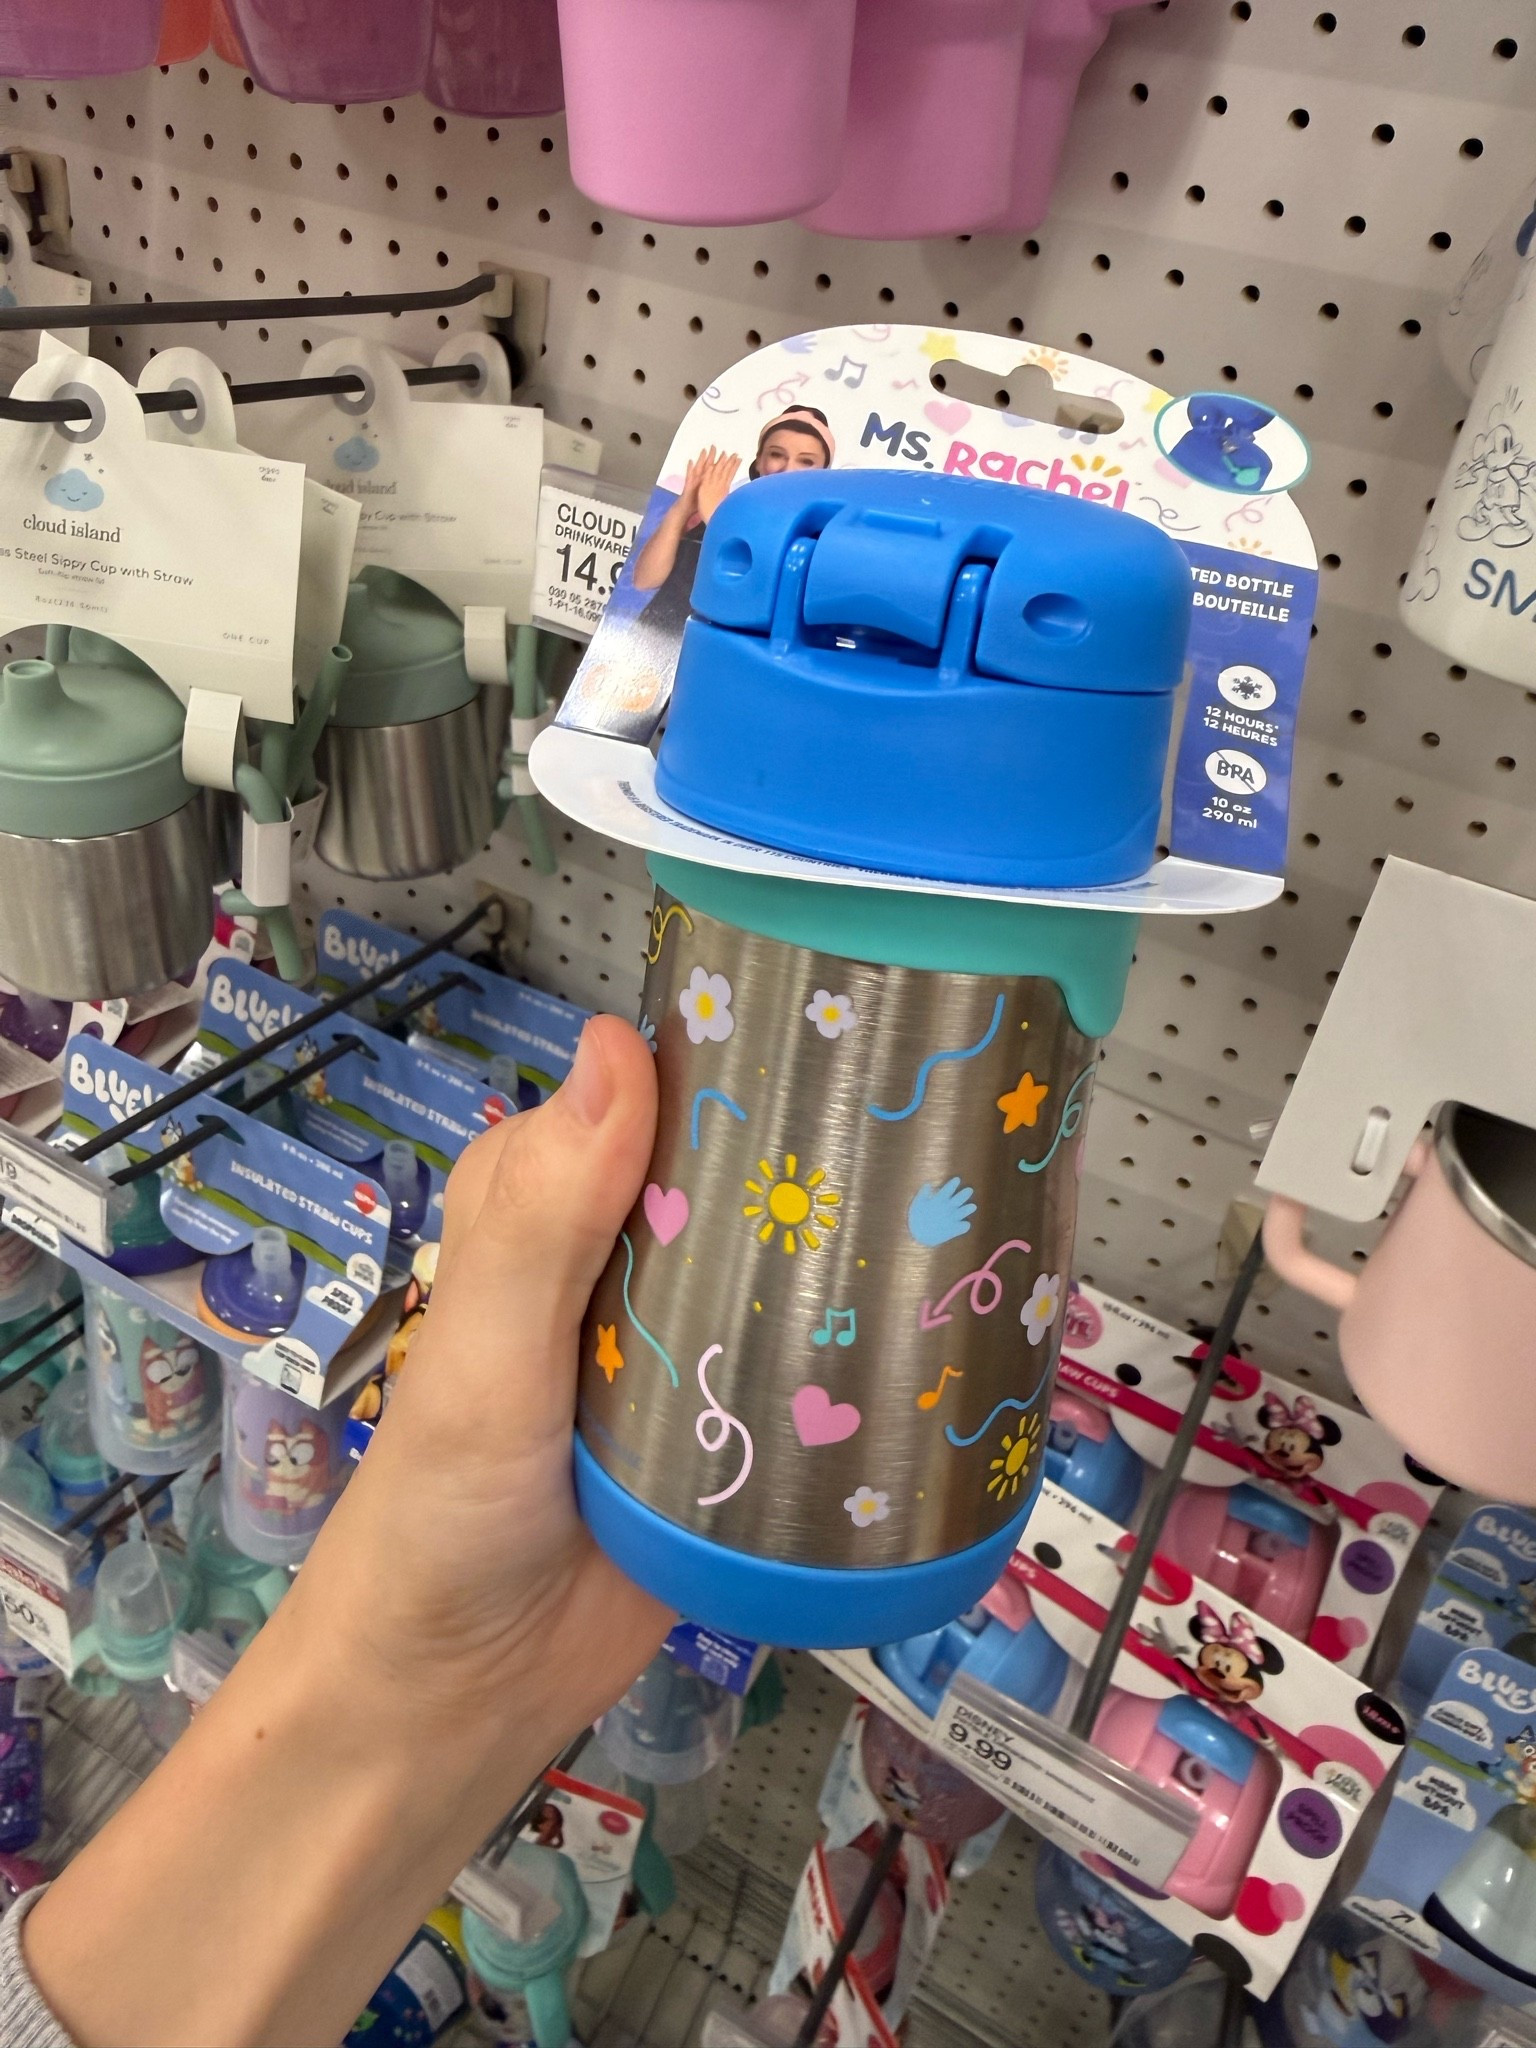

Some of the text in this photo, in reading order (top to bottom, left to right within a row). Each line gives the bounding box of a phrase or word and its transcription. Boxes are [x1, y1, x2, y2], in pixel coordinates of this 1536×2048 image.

[943, 440, 1129, 511] Rachel
[23, 514, 121, 543] cloud island
[557, 503, 626, 539] CLOUD
[555, 524, 631, 558] DRINKWARE
[15, 548, 48, 563] Steel
[51, 552, 87, 571] Sippy
[90, 560, 117, 575] Cup
[120, 567, 149, 579] with
[153, 569, 194, 586] Straw
[1225, 573, 1294, 598] BOTTLE
[1192, 591, 1290, 623] BOUTEILLE
[1205, 705, 1221, 718] 12
[1203, 717, 1278, 747] 12 HEURES
[1202, 807, 1257, 829] 290 ml
[1211, 796, 1252, 815] 10 oz
[1457, 1659, 1536, 1714] BLUE
[956, 1705, 1015, 1743] DISNEY
[948, 1722, 1013, 1771] 9.99
